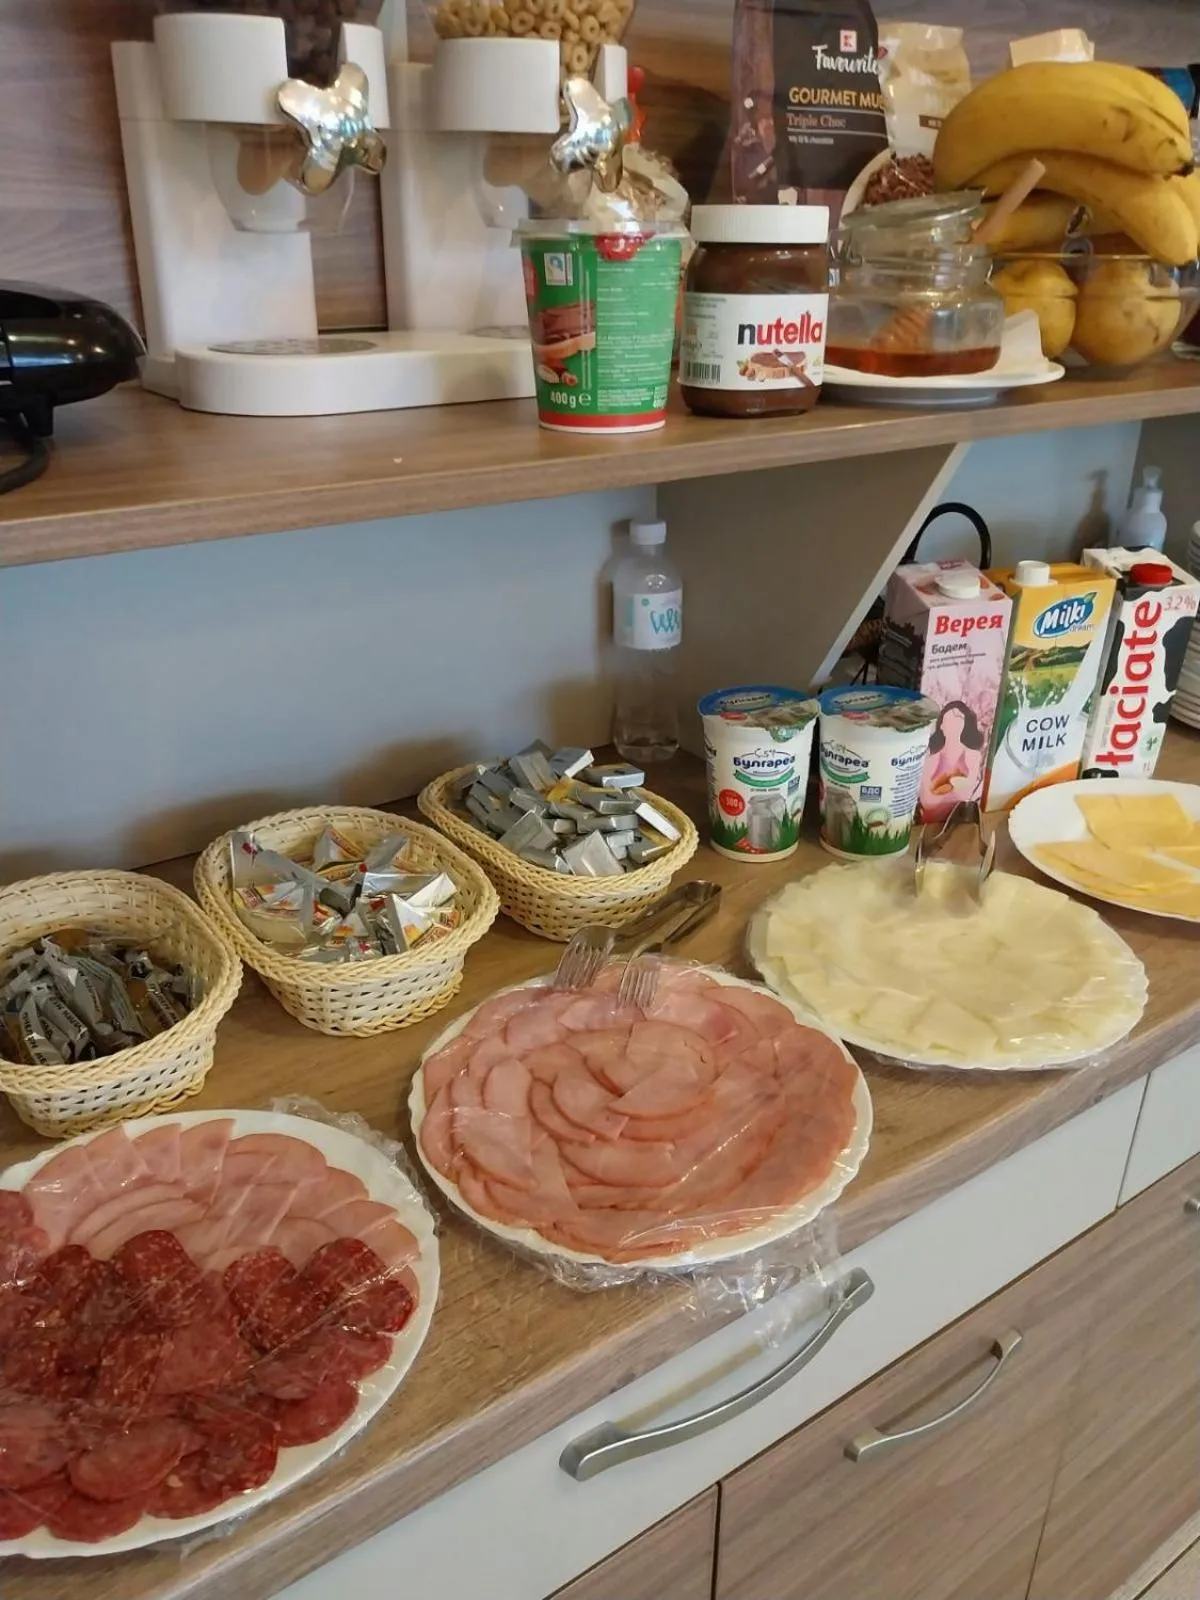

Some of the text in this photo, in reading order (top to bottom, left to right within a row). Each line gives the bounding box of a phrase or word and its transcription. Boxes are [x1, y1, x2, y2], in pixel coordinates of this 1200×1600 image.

[789, 87, 857, 106] GOURMET
[786, 112, 847, 129] Triple Choc
[737, 311, 823, 345] nutella
[934, 614, 1004, 637] Верея
[1040, 601, 1086, 634] Milki
[932, 642, 968, 655] Бадем
[1026, 714, 1070, 733] COW
[1022, 733, 1067, 752] MILK
